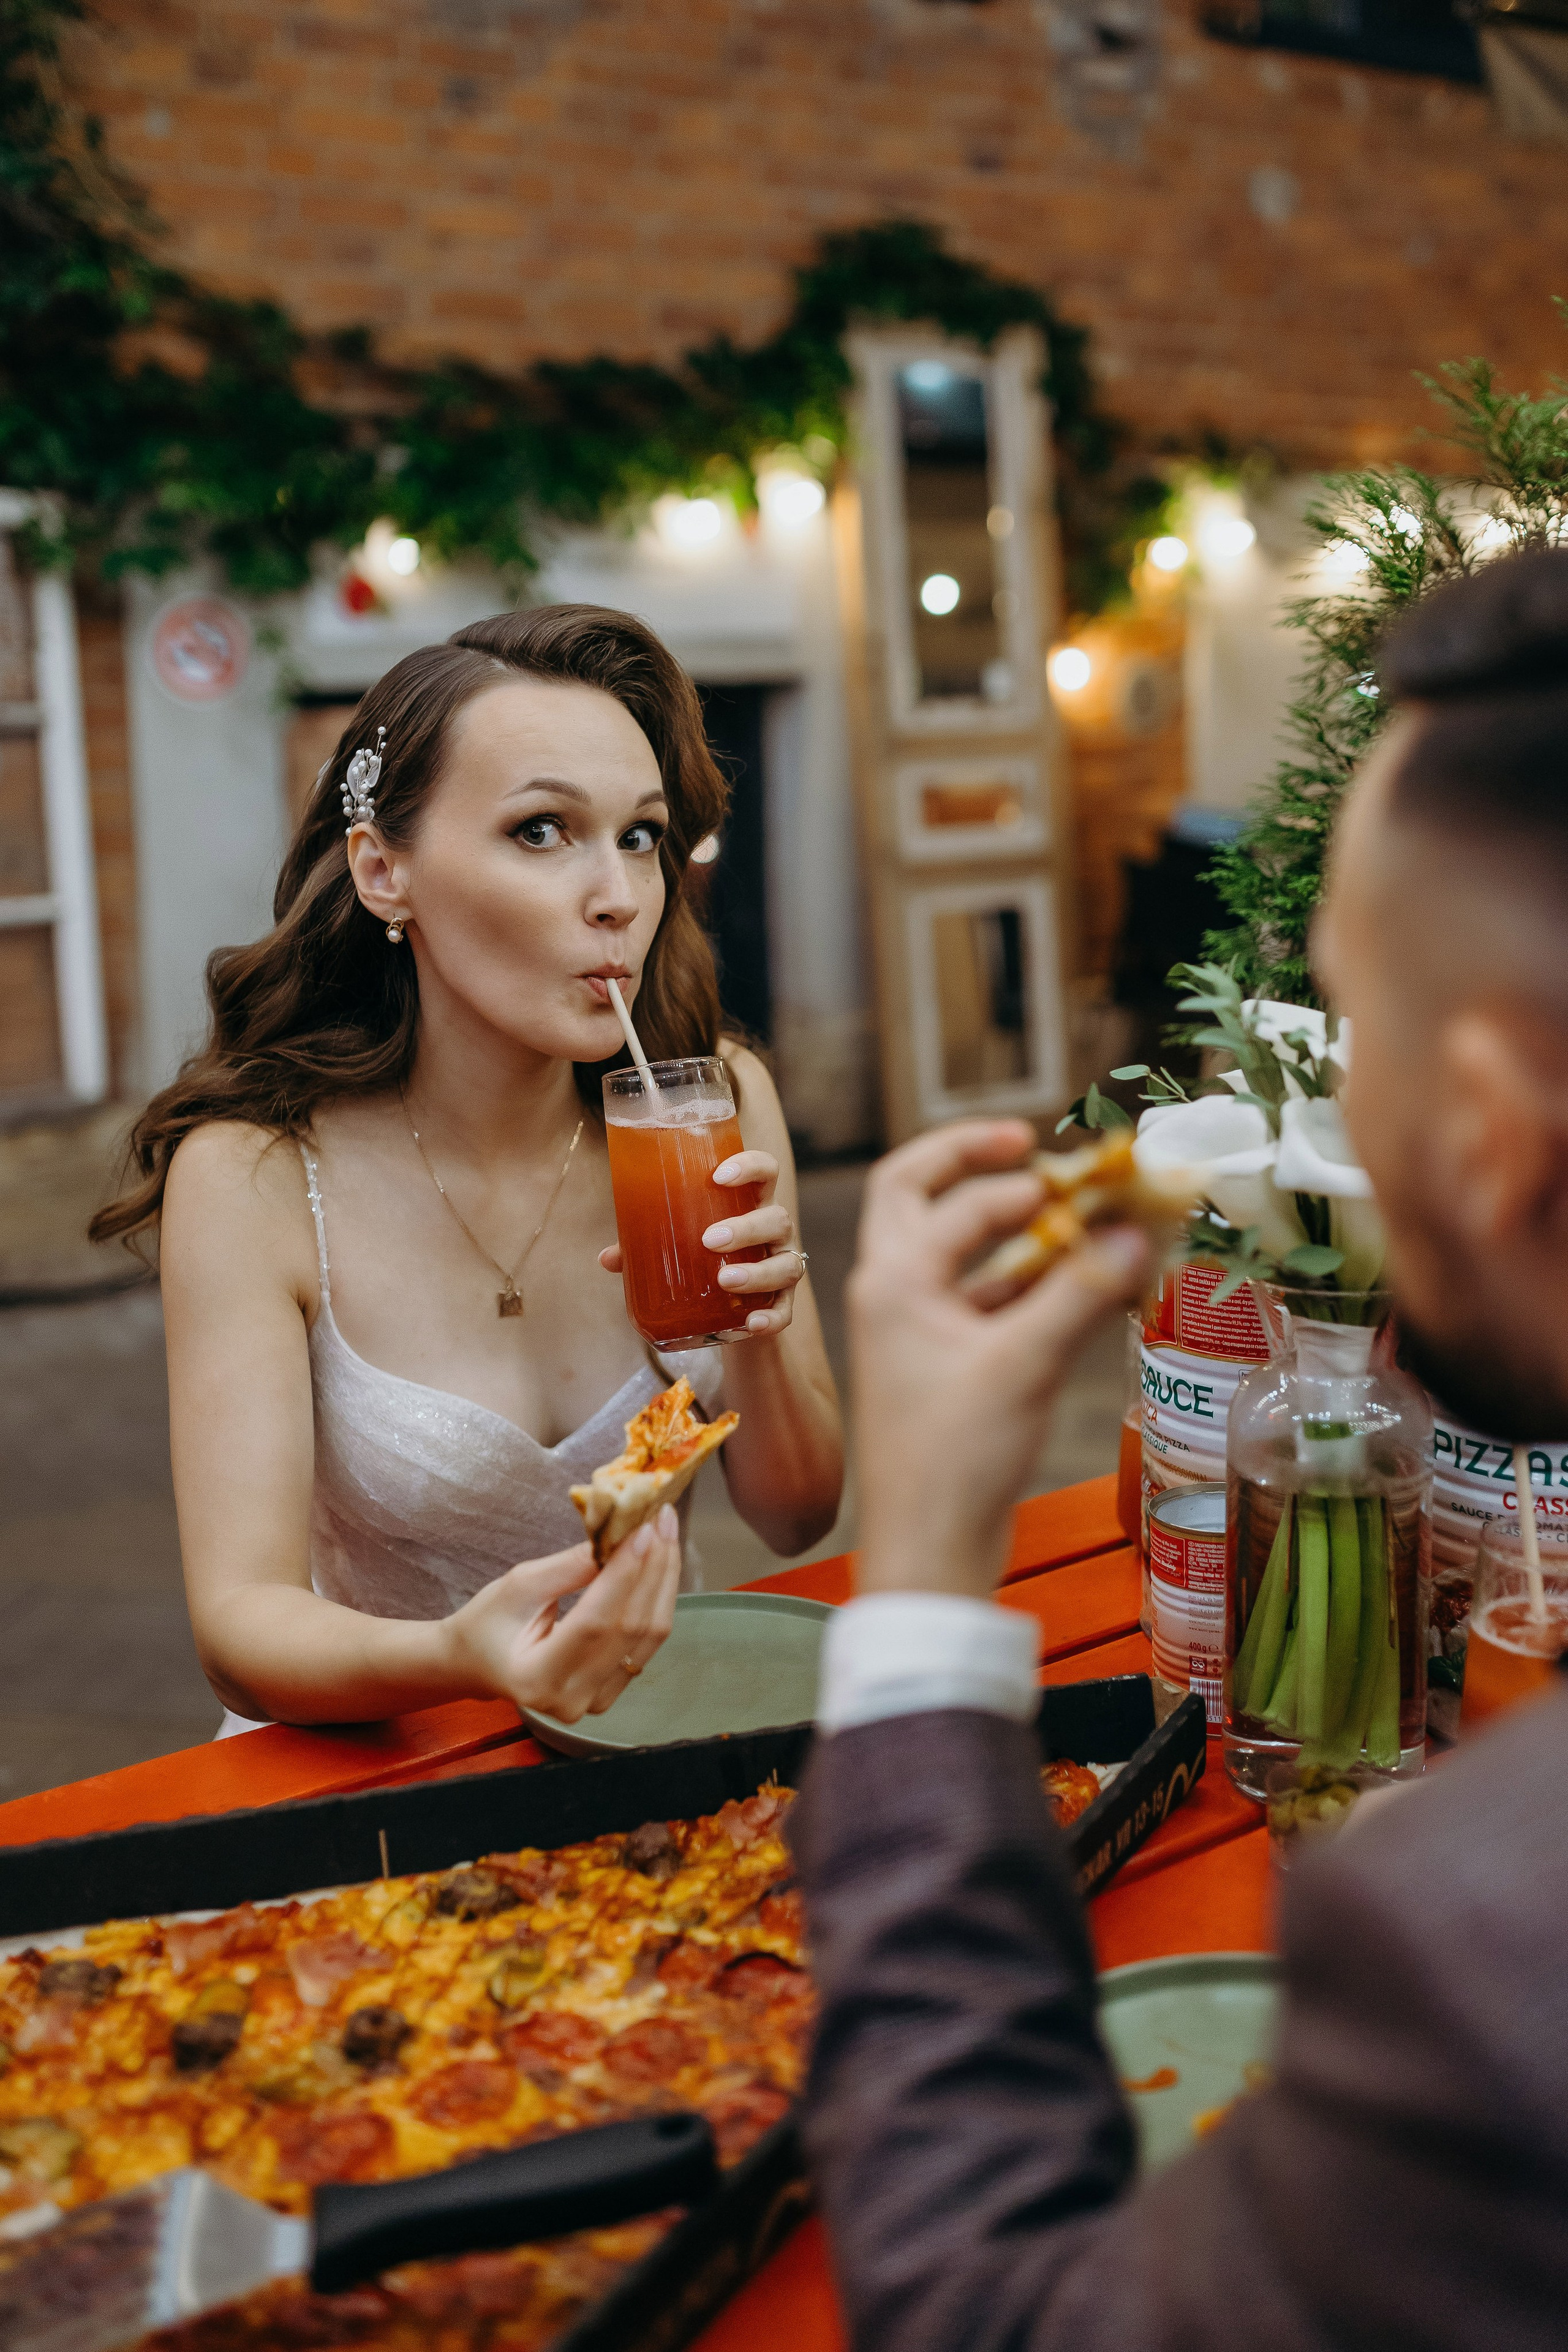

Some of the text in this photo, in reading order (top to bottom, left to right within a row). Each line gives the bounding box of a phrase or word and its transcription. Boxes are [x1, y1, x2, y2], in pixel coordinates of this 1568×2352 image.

[1141, 1359, 1213, 1419] SAUCE
[1164, 1436, 1190, 1452] PIZZA
[1451, 1502, 1493, 1521] SAUCE
[1189, 1642, 1200, 1651] 400
